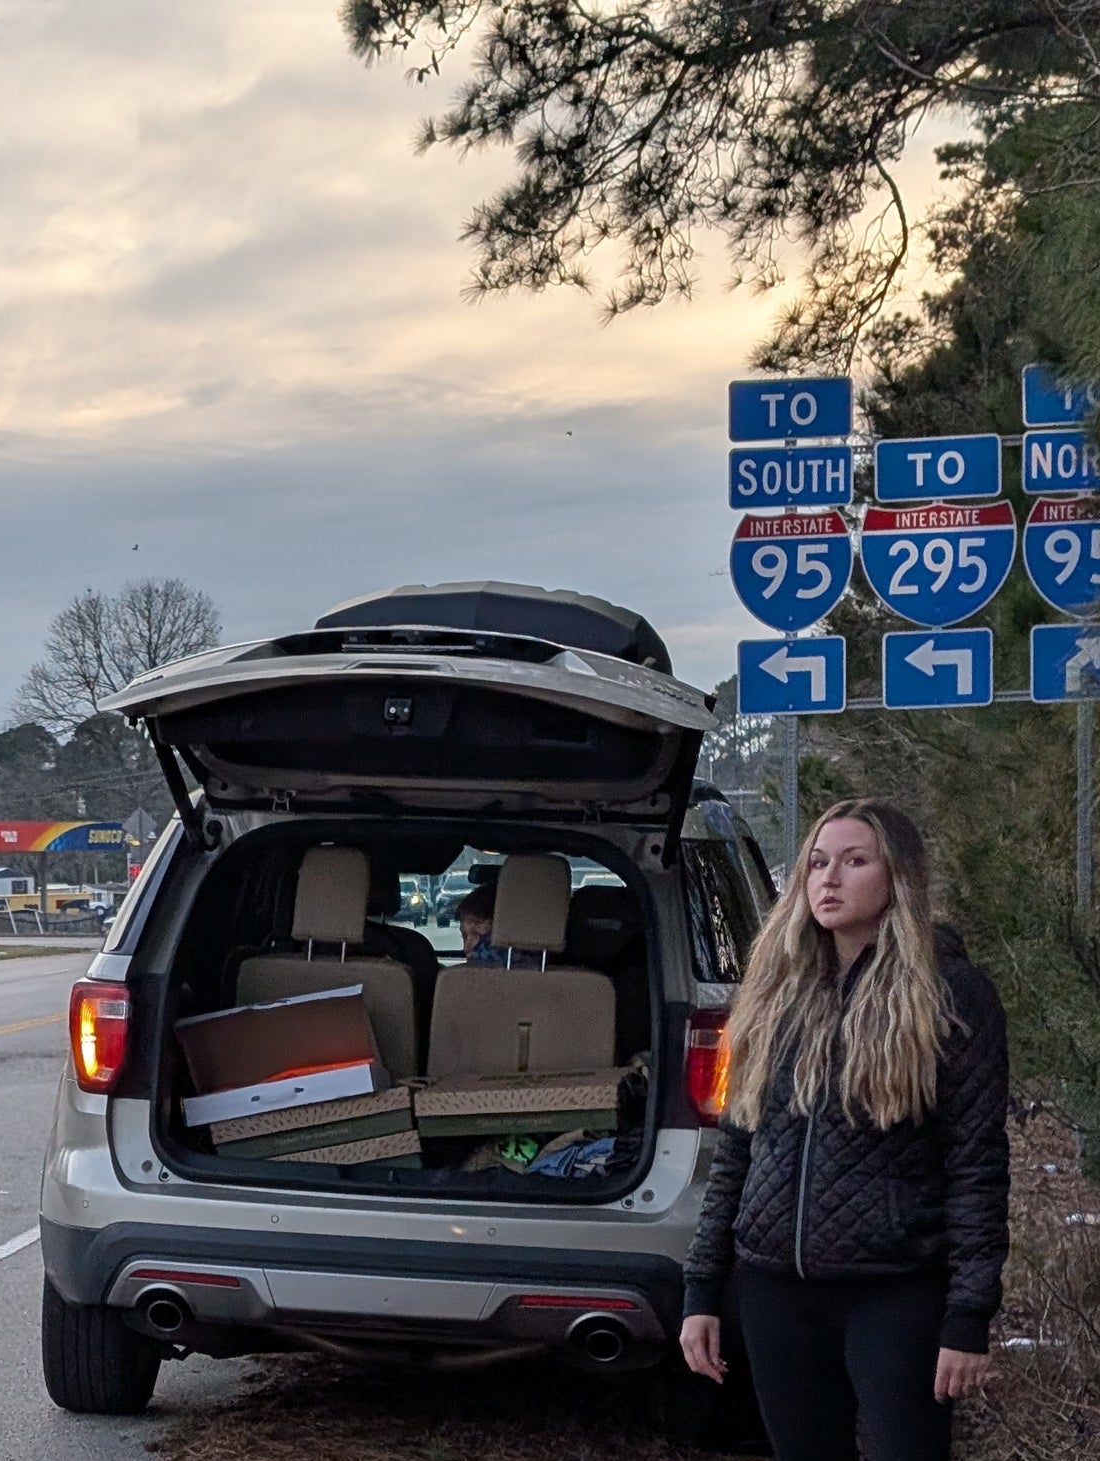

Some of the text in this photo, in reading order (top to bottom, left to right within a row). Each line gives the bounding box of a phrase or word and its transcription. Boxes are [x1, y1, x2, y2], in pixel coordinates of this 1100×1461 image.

[760, 392, 817, 427] TO
[737, 459, 845, 496] SOUTH
[908, 451, 965, 486] TO
[750, 517, 833, 536] INTERSTATE
[895, 510, 980, 529] INTERSTATE
[751, 543, 832, 600] 95
[888, 537, 987, 596] 295
[88, 829, 124, 844] SUNOCO
